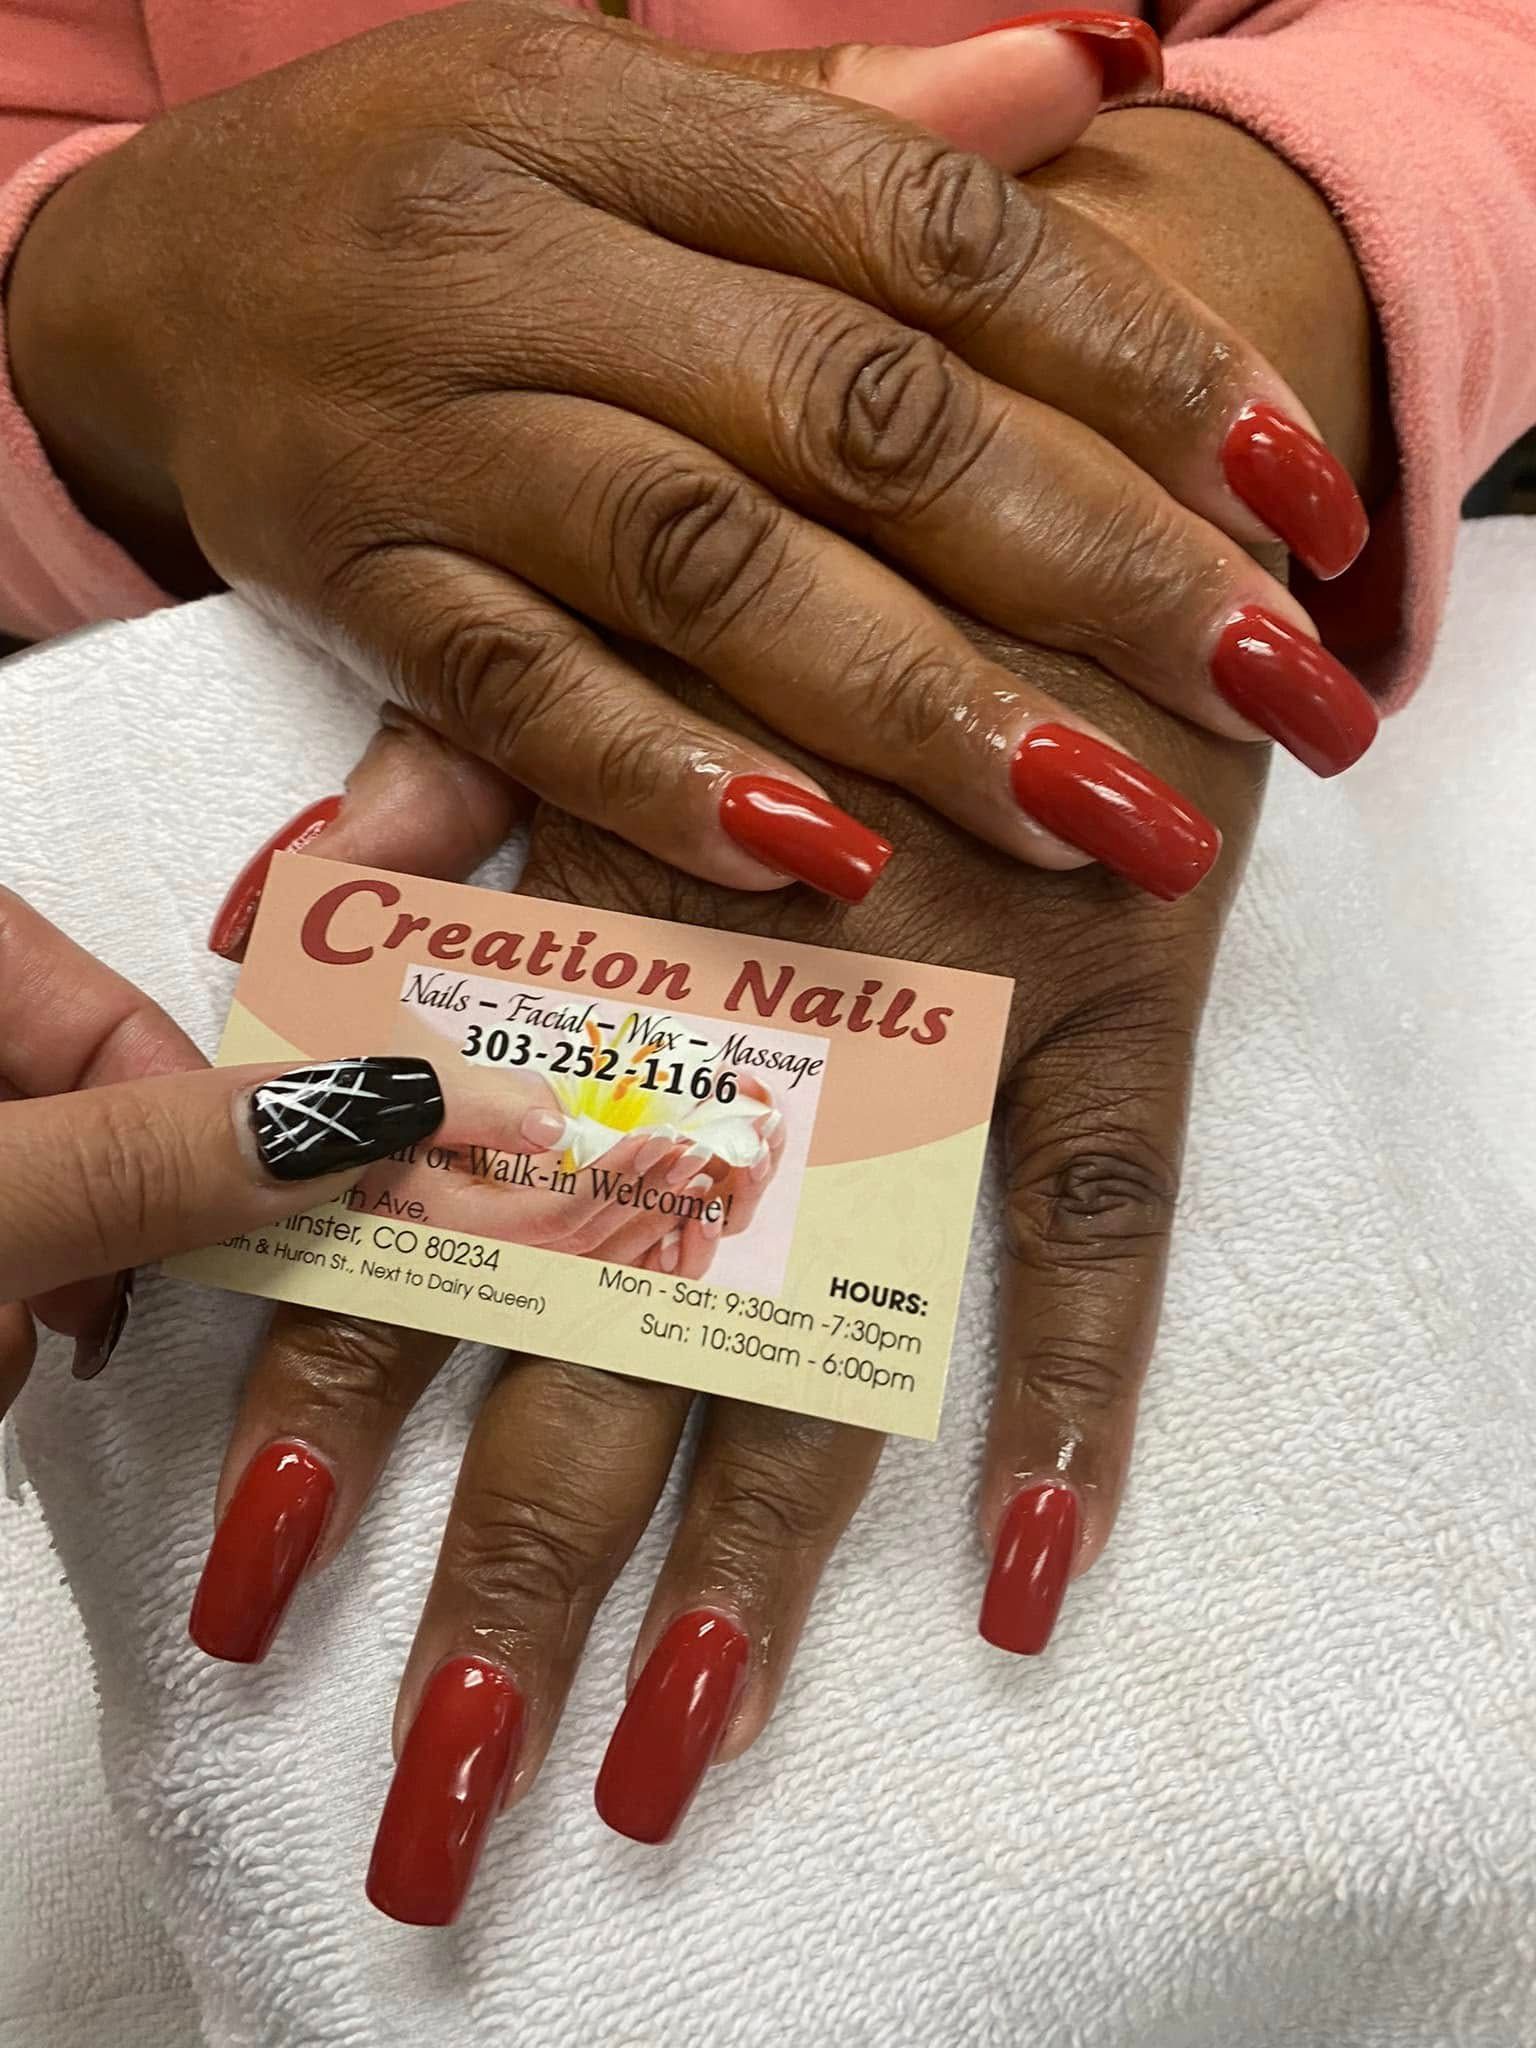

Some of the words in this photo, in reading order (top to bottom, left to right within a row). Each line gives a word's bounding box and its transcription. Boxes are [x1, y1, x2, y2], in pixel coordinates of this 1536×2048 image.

[300, 879, 692, 1001] Creation
[724, 959, 954, 1045] Nails
[401, 973, 471, 1012] Nails
[506, 993, 598, 1034] Facial
[627, 1012, 683, 1054] Wax
[702, 1032, 825, 1091] Massage
[461, 1024, 738, 1104] 303-252-1166
[373, 1190, 430, 1222] Ave,
[426, 1147, 459, 1171] or
[469, 1145, 577, 1196] Walk-in
[591, 1167, 734, 1226] Welcome!
[255, 1237, 270, 1255] &
[274, 1241, 326, 1267] Huron
[360, 1259, 402, 1283] Next
[405, 1269, 424, 1286] to
[427, 1273, 475, 1300] Dairy
[478, 1284, 546, 1315] Queen)
[373, 1226, 418, 1254] CO
[425, 1236, 501, 1272] 80234
[599, 1266, 652, 1297] Mon
[672, 1281, 718, 1311] Sat:
[725, 1293, 815, 1332] 9:30am
[829, 1276, 929, 1317] HOURS:
[640, 1312, 690, 1343] Sun:
[701, 1325, 801, 1368] 10:30am
[822, 1352, 916, 1393] 6:00pm
